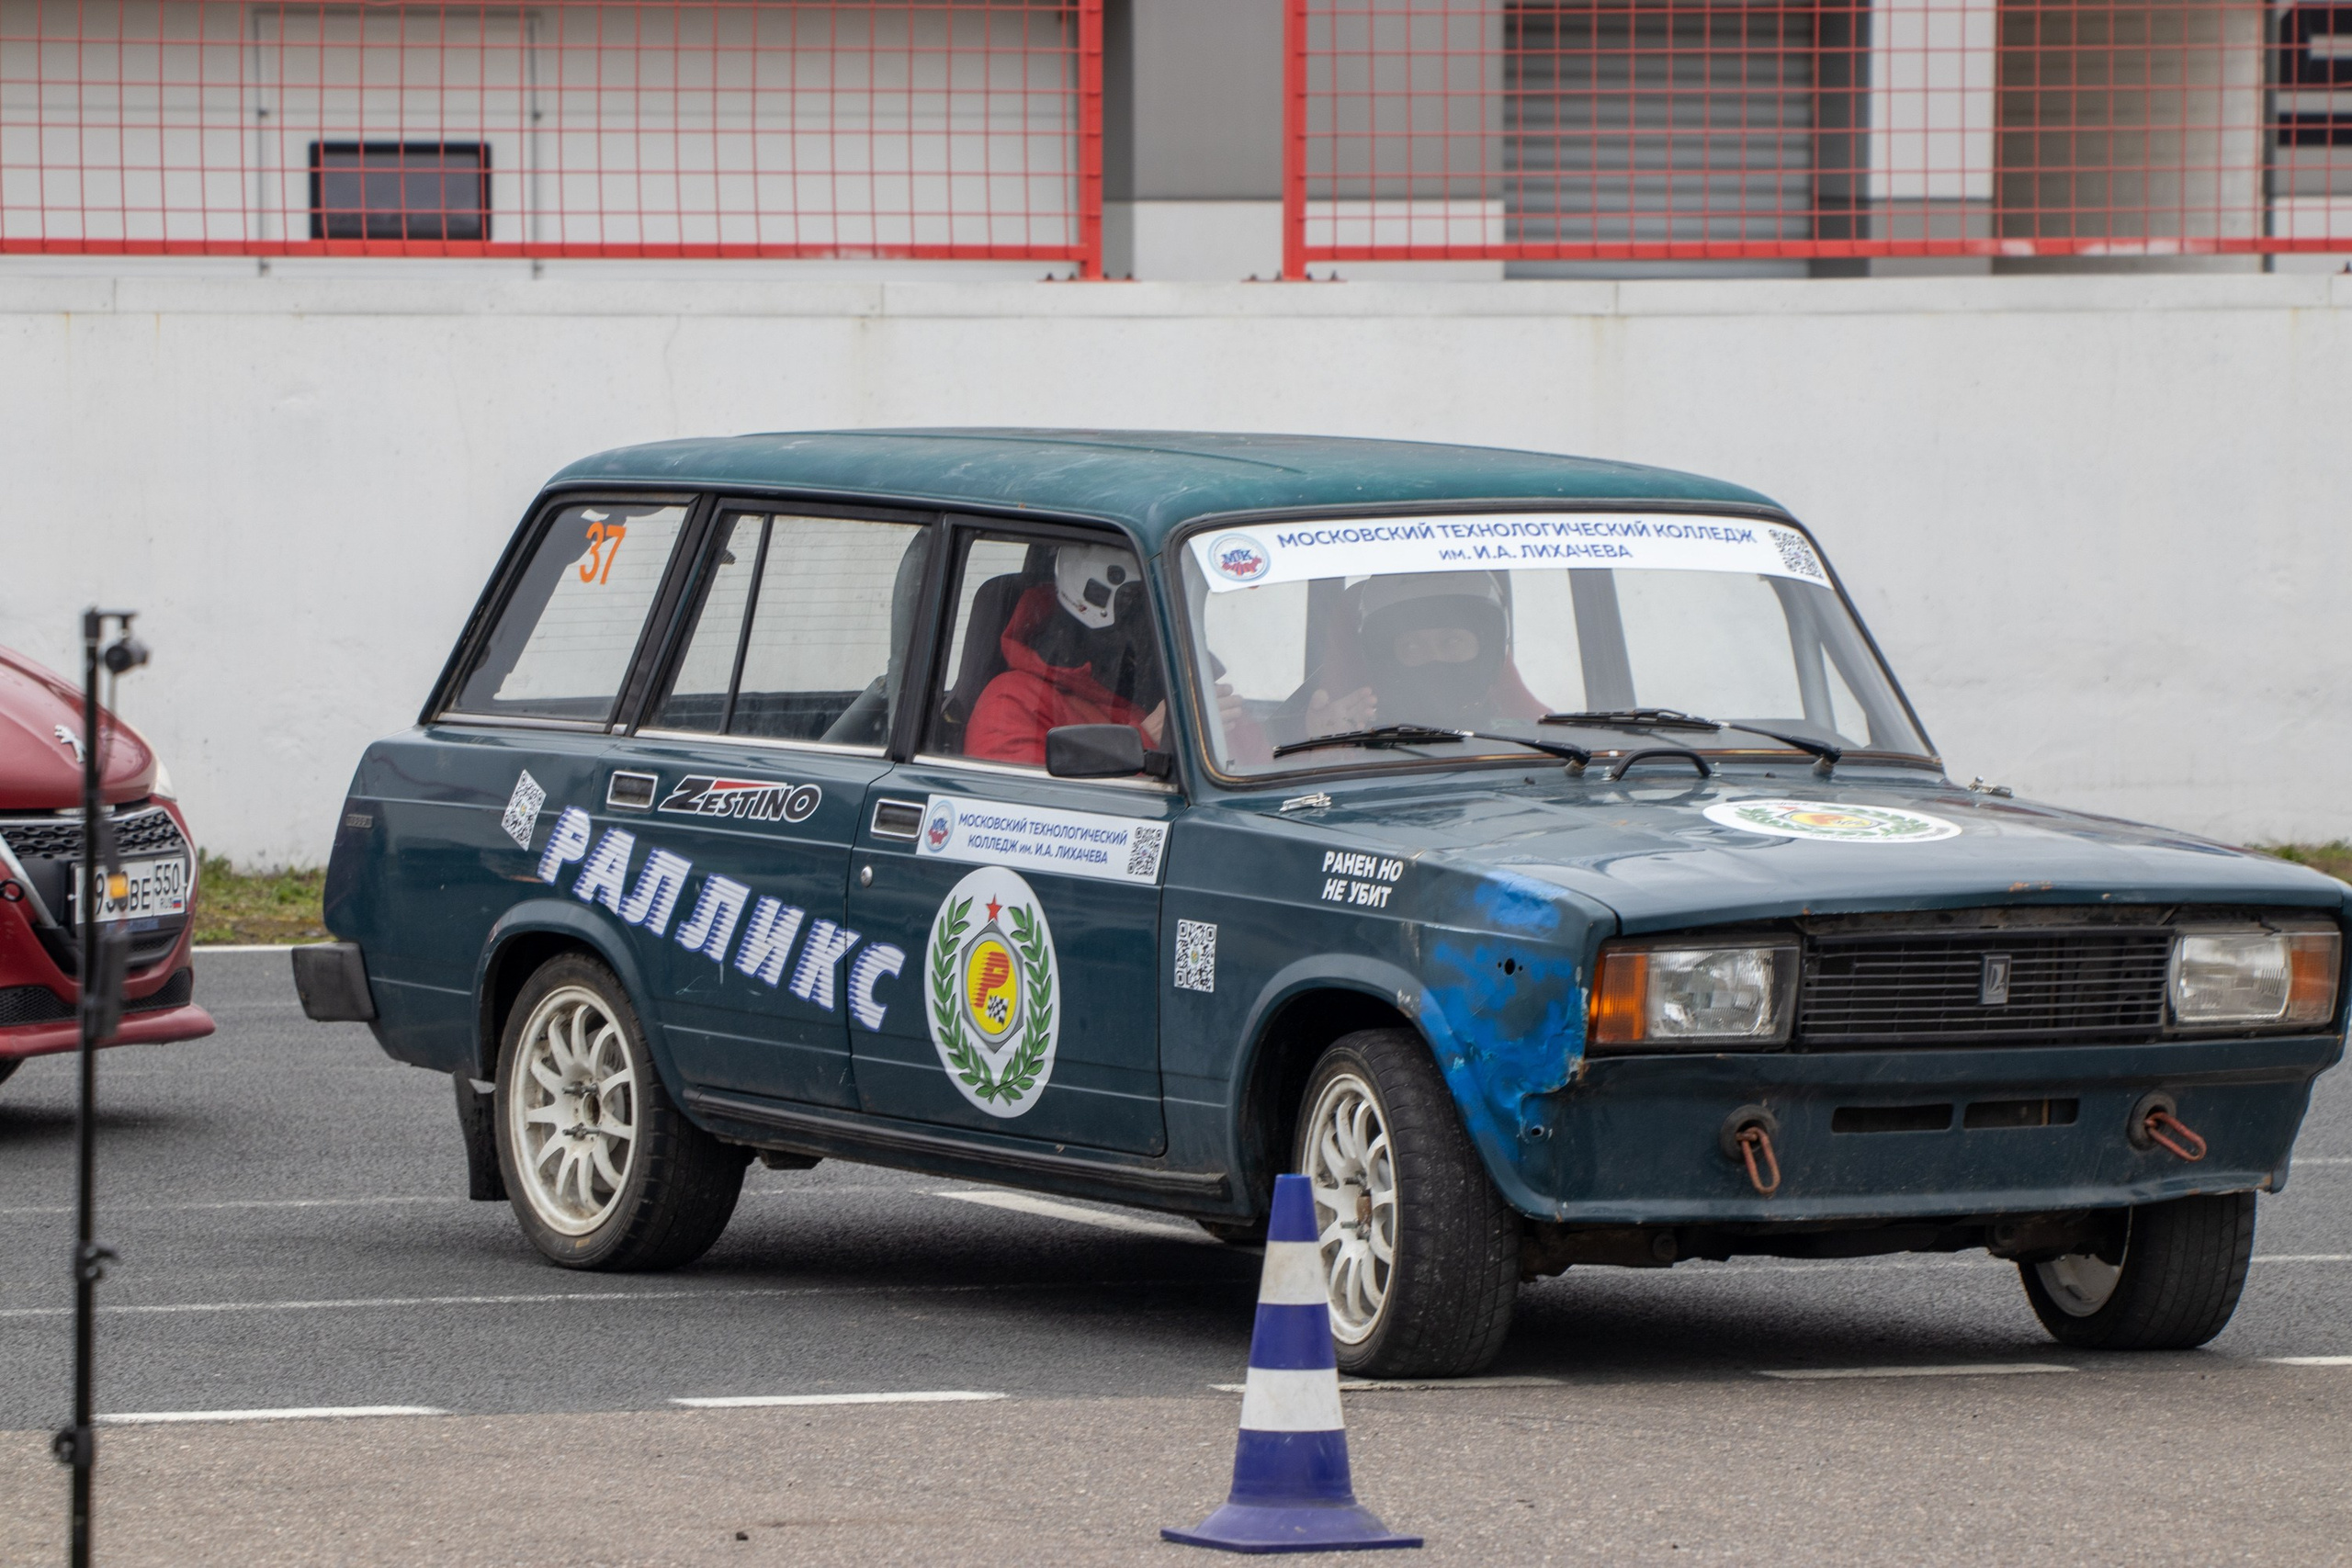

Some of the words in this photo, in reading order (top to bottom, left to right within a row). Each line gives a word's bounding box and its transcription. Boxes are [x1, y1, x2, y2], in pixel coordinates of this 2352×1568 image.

[1276, 522, 1433, 548] МОСКОВСКИЙ
[1437, 520, 1651, 539] ТЕХНОЛОГИЧЕСКИЙ
[1654, 524, 1757, 545] КОЛЛЕДЖ
[579, 521, 627, 585] 37
[1521, 544, 1634, 559] ЛИХАЧЕВА
[658, 774, 822, 823] ZESTINO
[958, 813, 1027, 834] МОСКОВСКИЙ
[1029, 821, 1129, 846] ТЕХНОЛОГИЧЕСКИЙ
[967, 835, 1019, 853] КОЛЛЕДЖ
[1055, 845, 1108, 863] ЛИХАЧЕВА
[154, 863, 180, 896] 550
[1321, 851, 1377, 878] РАНЕН
[1376, 858, 1404, 882] НО
[1321, 877, 1348, 901] НЕ
[1347, 881, 1393, 908] УБИТ
[537, 805, 907, 1032] РАЛЛИКС
